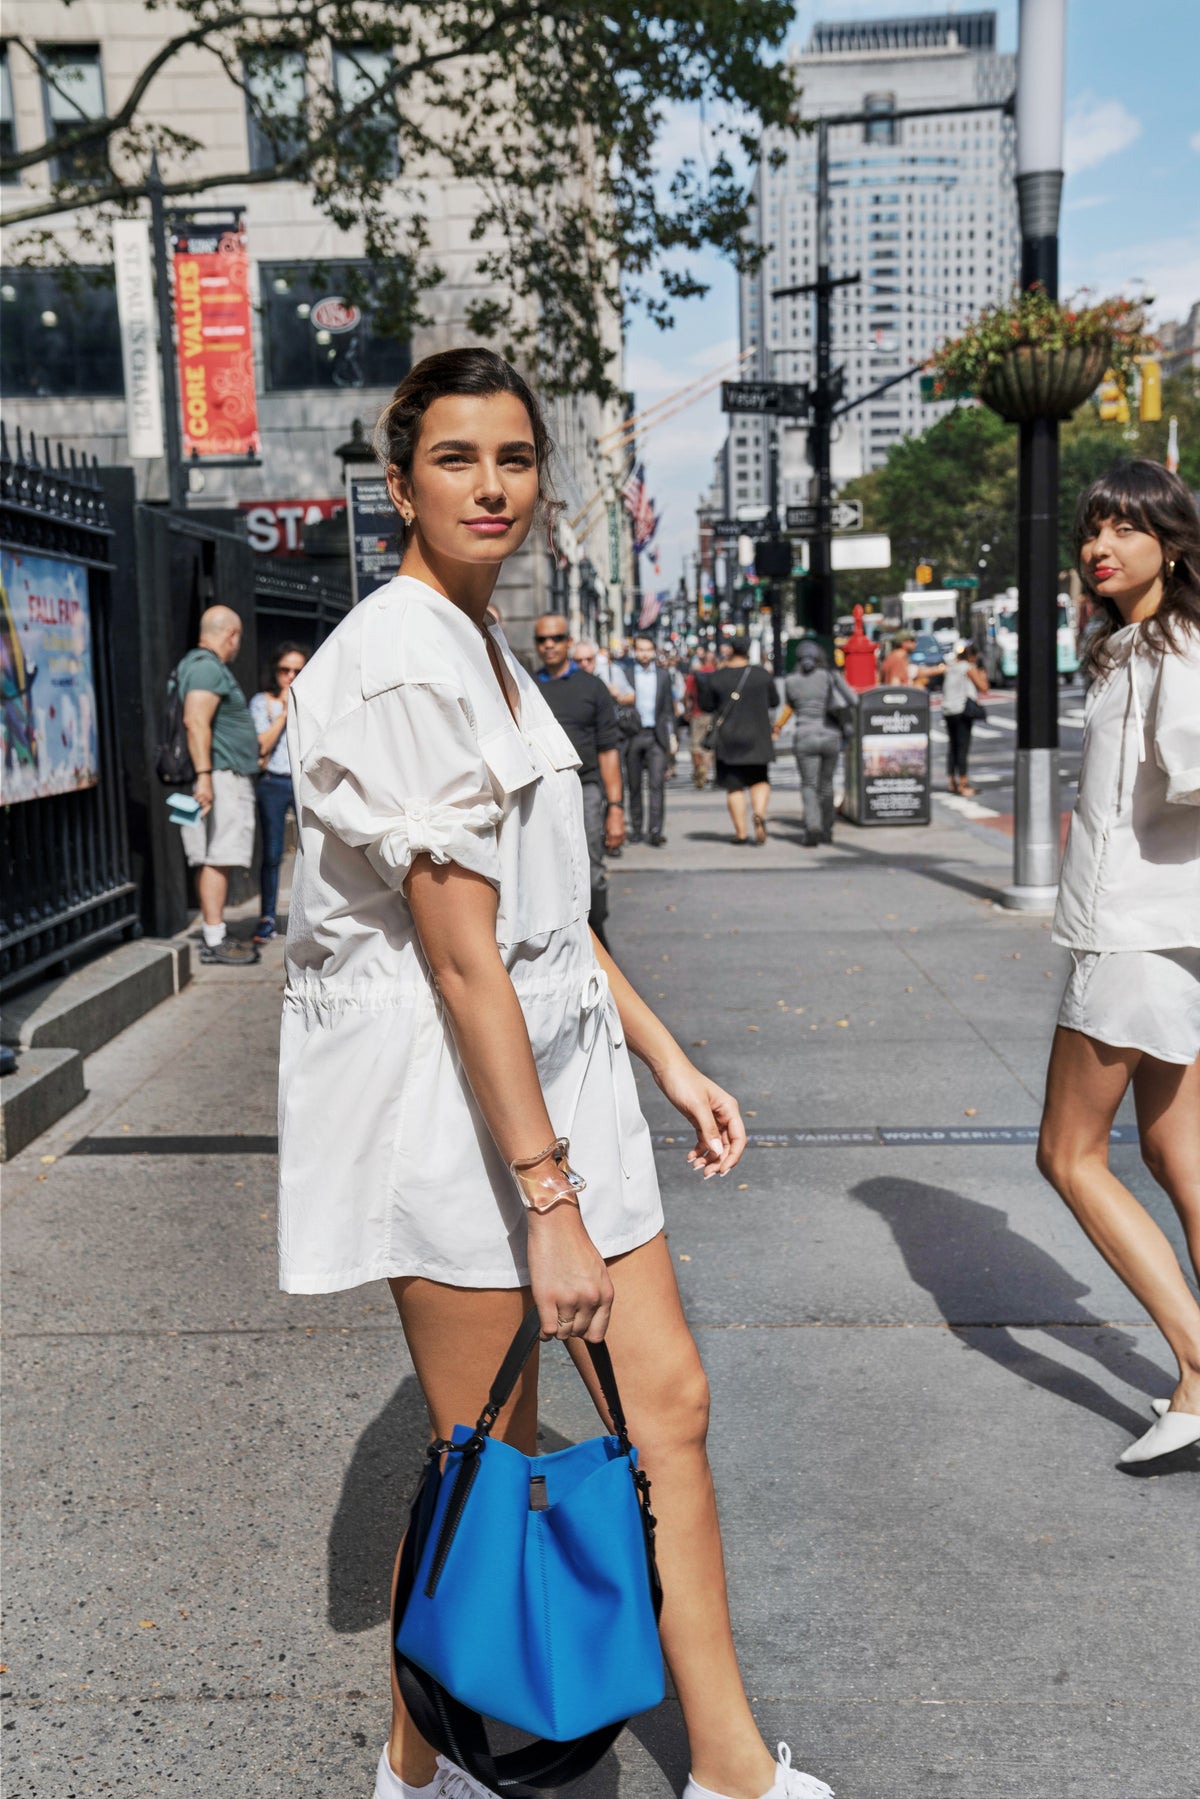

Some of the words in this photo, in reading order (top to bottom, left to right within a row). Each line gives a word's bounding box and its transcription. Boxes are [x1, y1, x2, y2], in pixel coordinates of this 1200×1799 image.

[179, 261, 203, 358] VALUES
[129, 348, 153, 433] CHAPEL
[186, 365, 209, 436] CORE
[28, 594, 57, 625] FALL
[795, 1133, 874, 1141] YANKEES
[882, 1131, 945, 1140] WORLD
[949, 1131, 1012, 1139] SERIES
